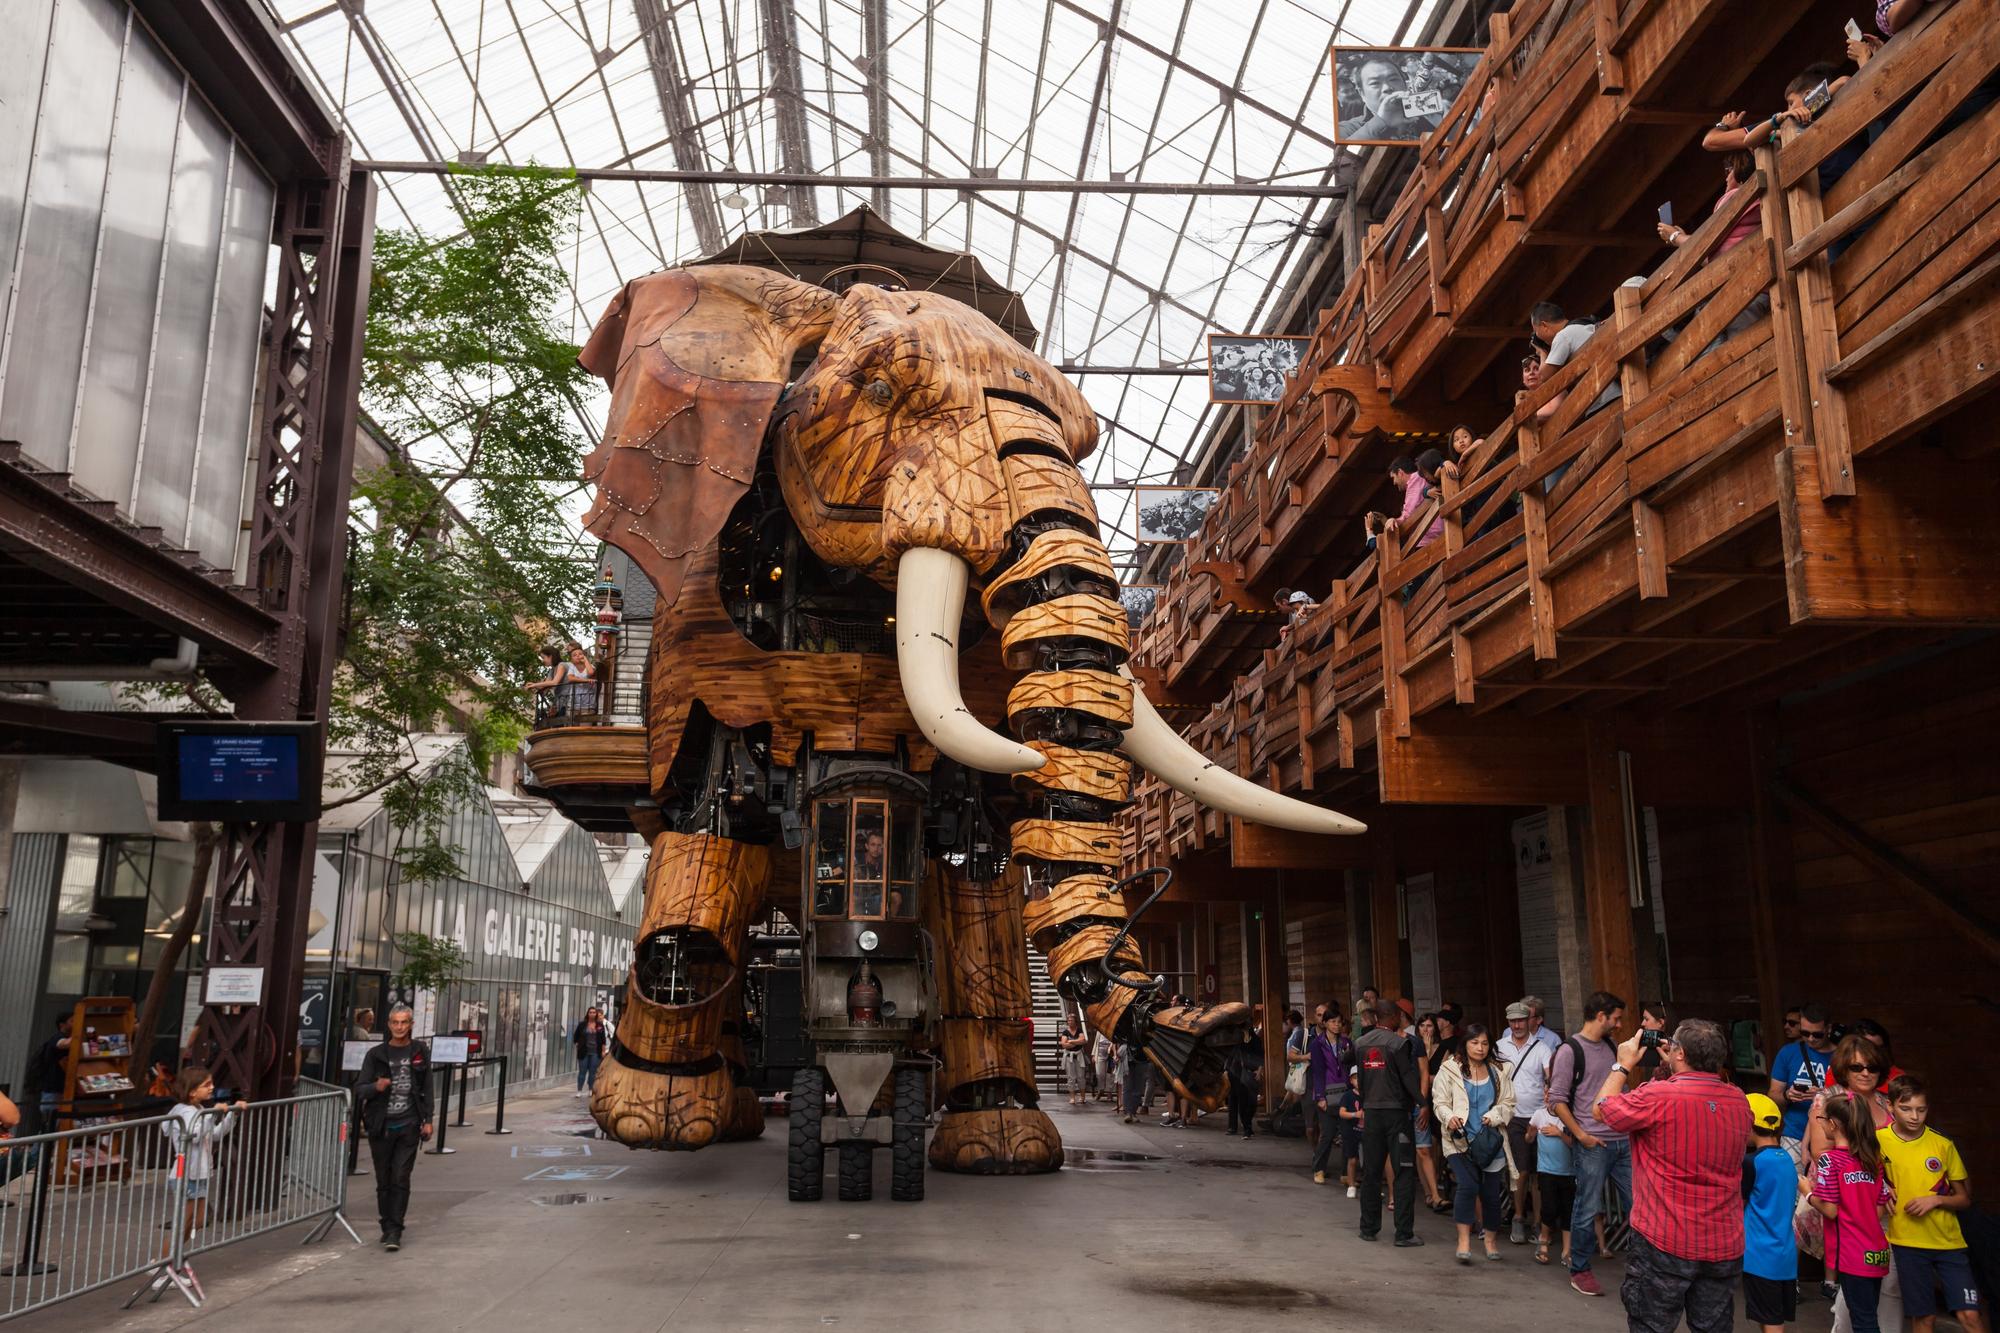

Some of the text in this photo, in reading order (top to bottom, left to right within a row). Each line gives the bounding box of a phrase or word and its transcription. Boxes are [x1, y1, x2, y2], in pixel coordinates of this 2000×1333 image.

[433, 899, 467, 953] LA
[484, 908, 562, 963] GALERIE
[569, 927, 595, 967] DES
